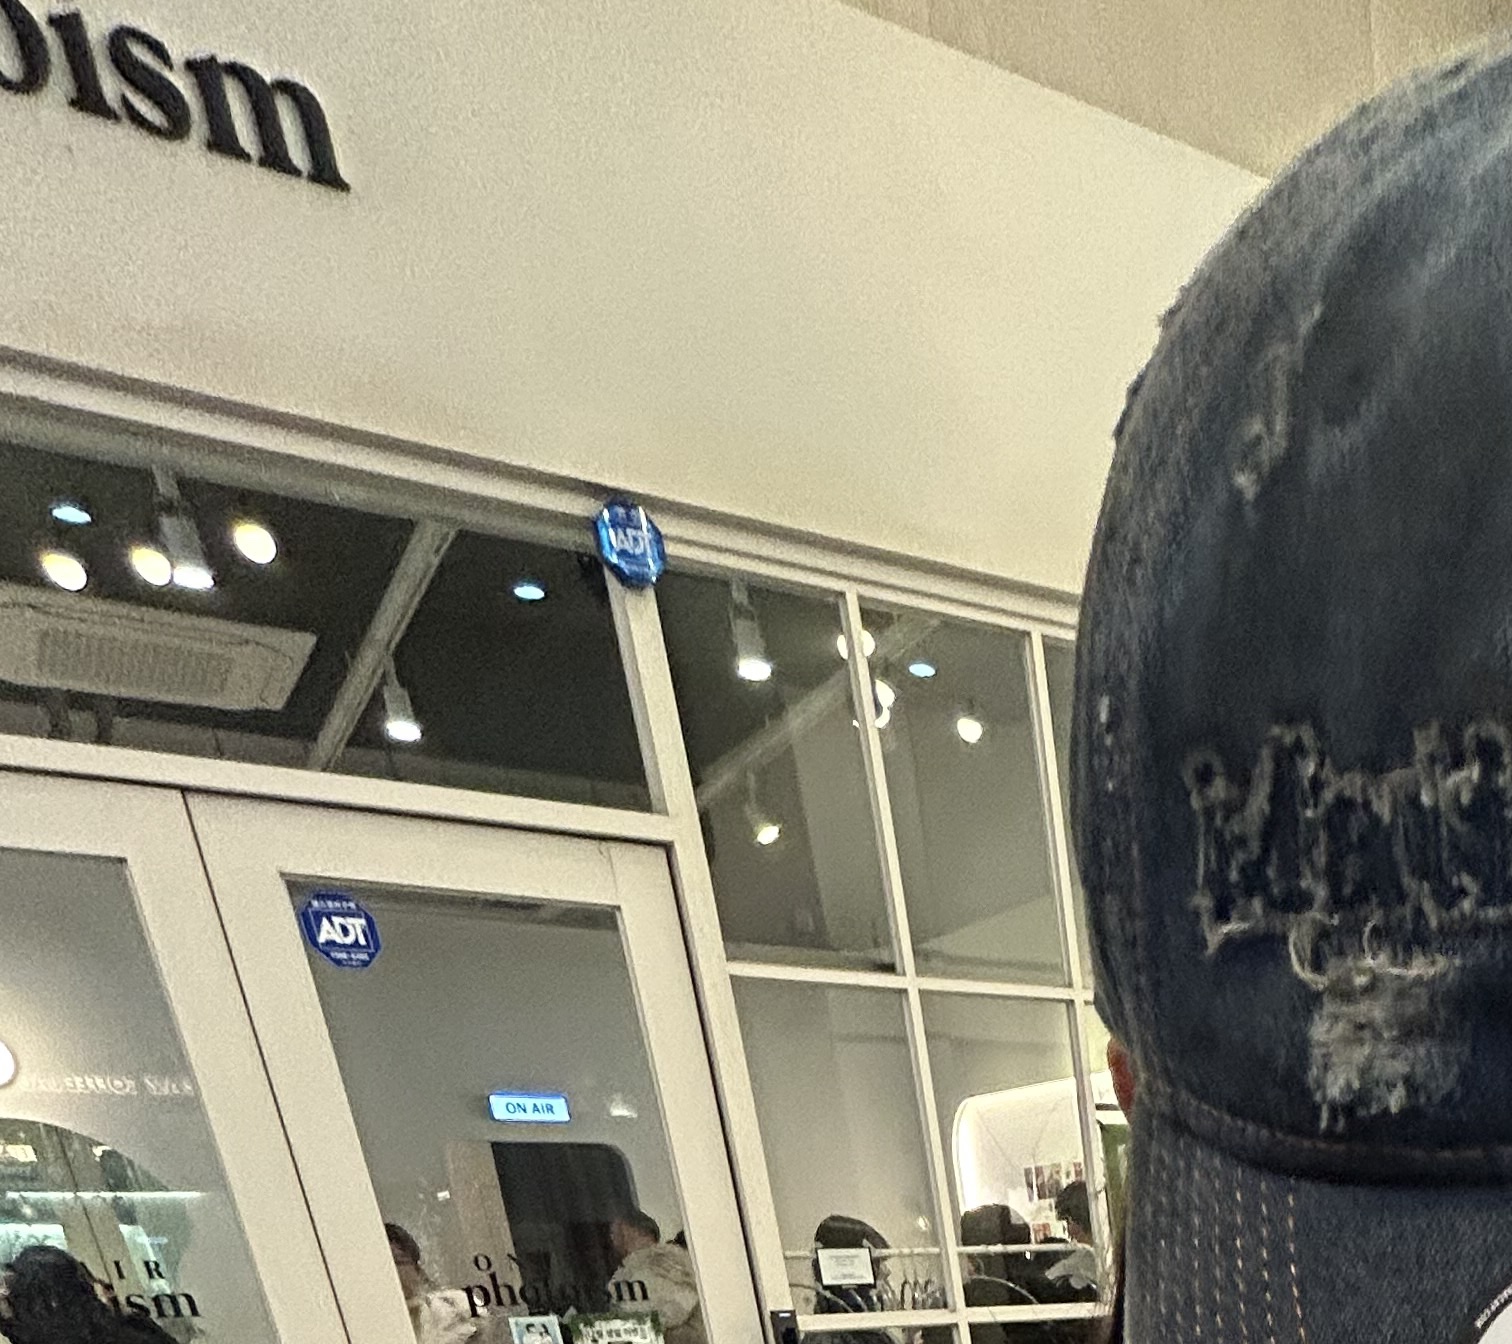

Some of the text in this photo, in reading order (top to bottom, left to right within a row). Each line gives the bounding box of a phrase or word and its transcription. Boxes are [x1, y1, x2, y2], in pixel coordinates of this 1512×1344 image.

[318, 915, 367, 946] ADT
[505, 1102, 555, 1115] ON AIR
